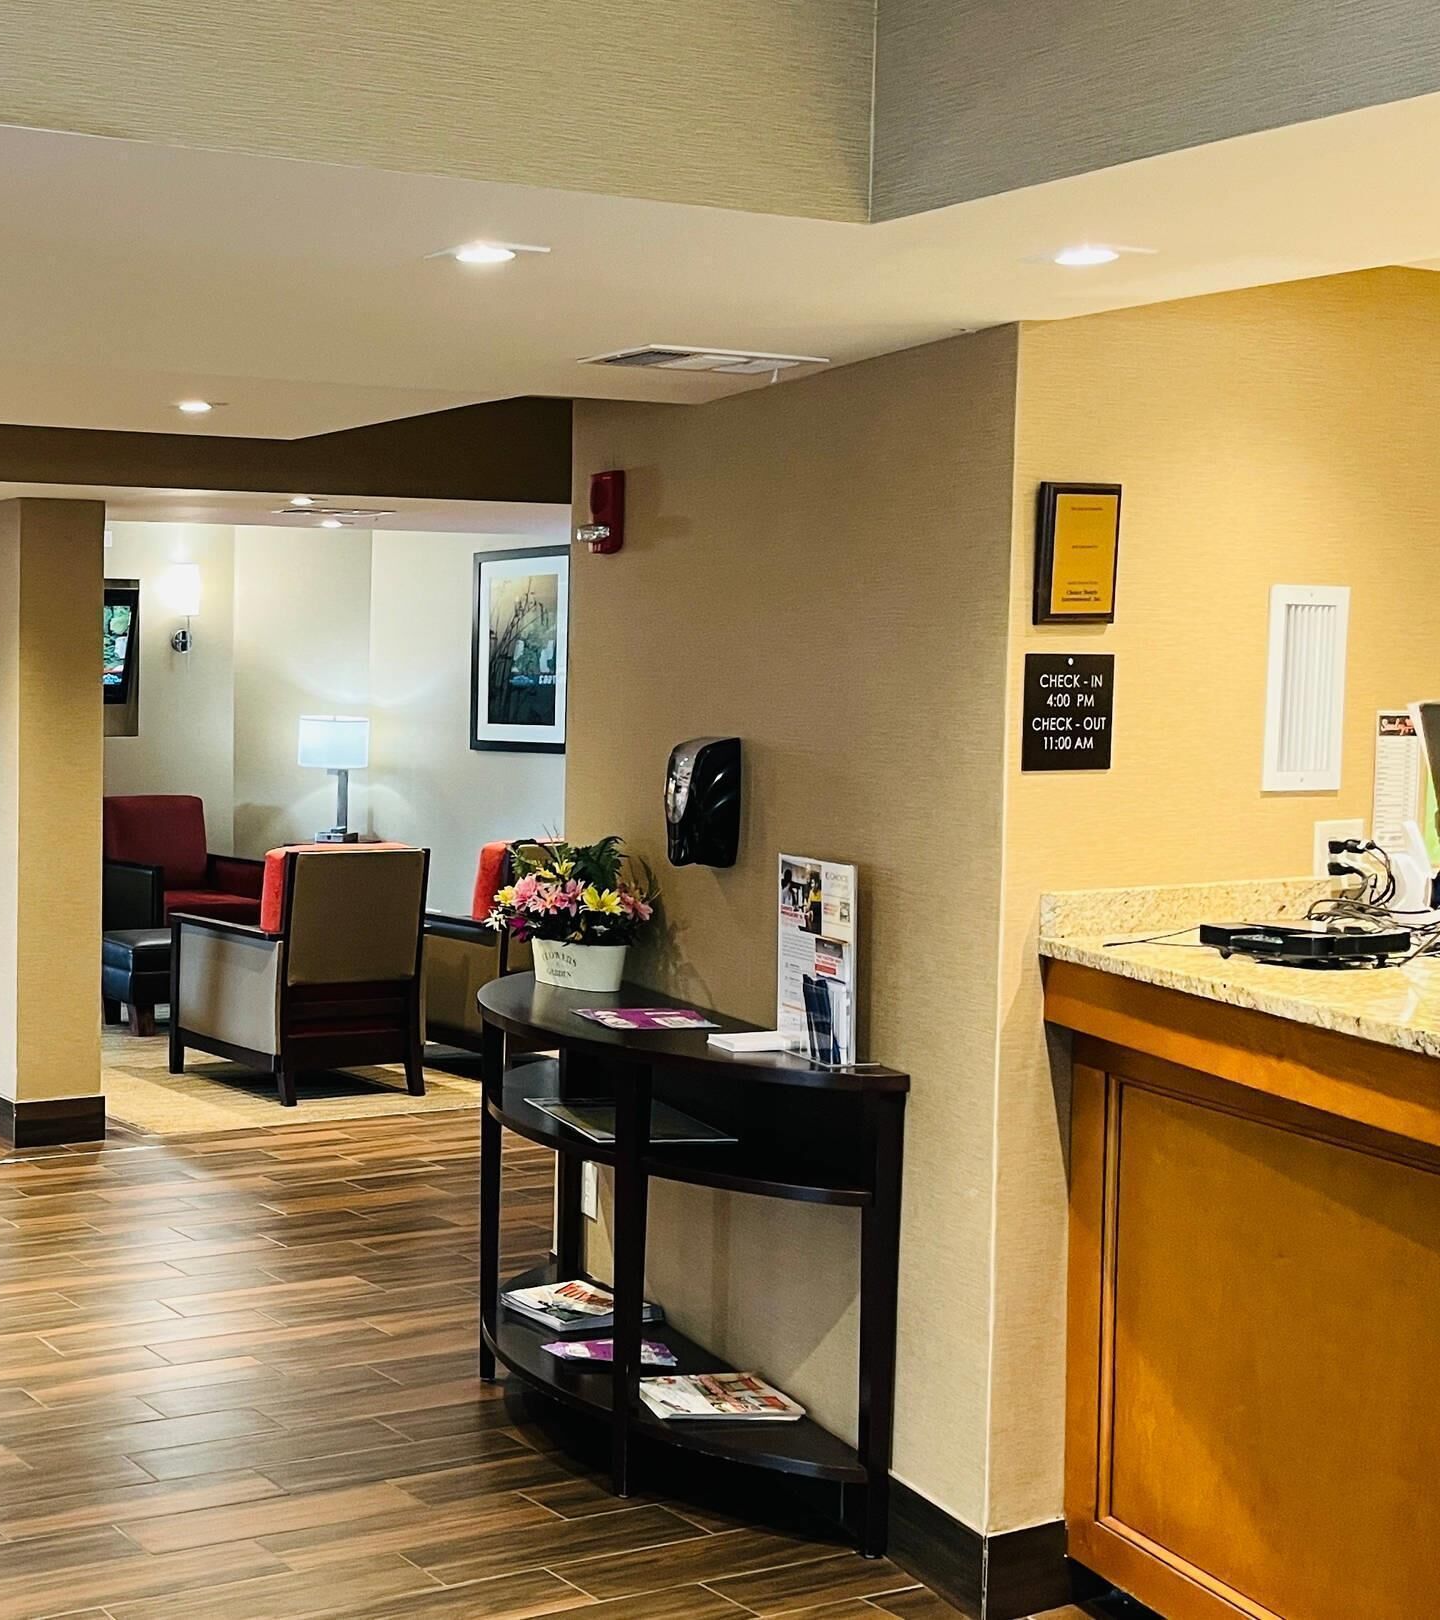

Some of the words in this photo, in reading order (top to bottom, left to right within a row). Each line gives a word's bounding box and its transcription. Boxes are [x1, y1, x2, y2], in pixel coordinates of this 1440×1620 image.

[1039, 674, 1080, 688] CHECK
[1091, 674, 1103, 688] IN
[1046, 693, 1071, 707] 4:00
[1077, 694, 1095, 707] PM
[1032, 717, 1073, 731] CHECK
[1083, 716, 1107, 730] OUT
[1044, 736, 1072, 750] 11:00
[1074, 736, 1094, 750] AM
